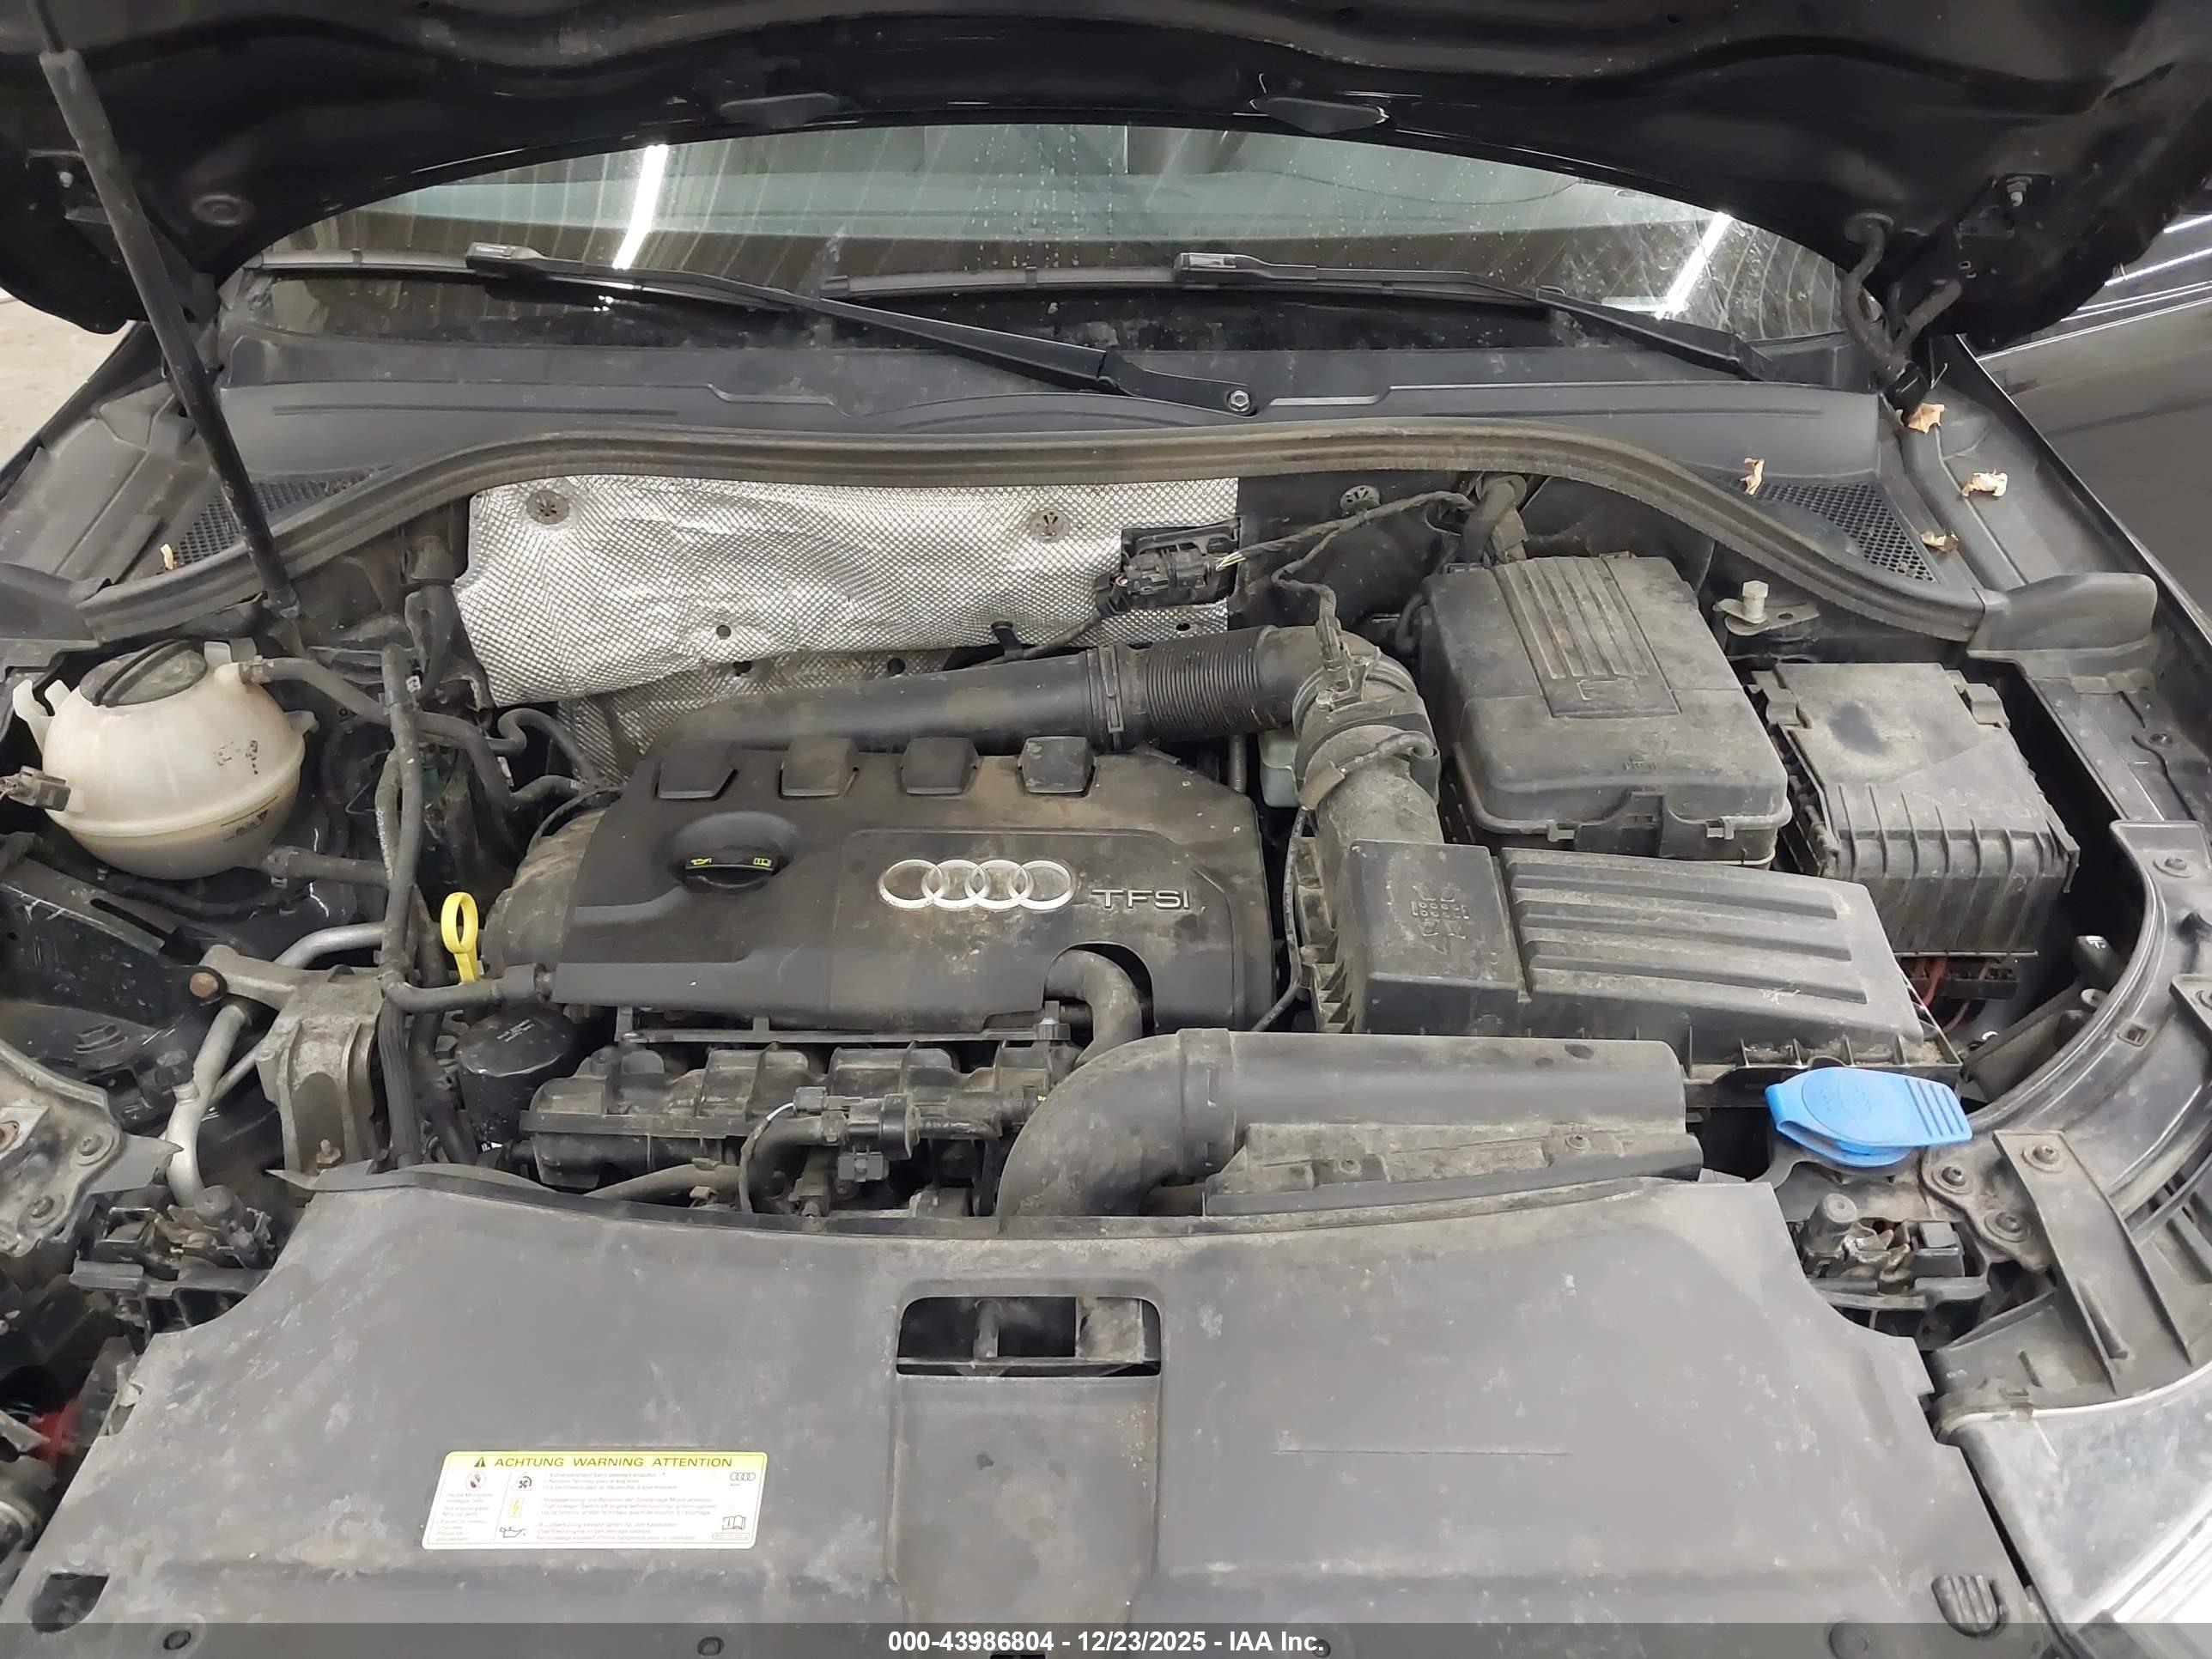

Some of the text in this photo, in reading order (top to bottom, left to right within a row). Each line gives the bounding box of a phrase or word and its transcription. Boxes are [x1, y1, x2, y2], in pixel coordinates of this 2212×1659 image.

[1091, 889, 1190, 910] TFSI
[495, 1457, 733, 1468] ACHTUNG WARNING ATTENTION
